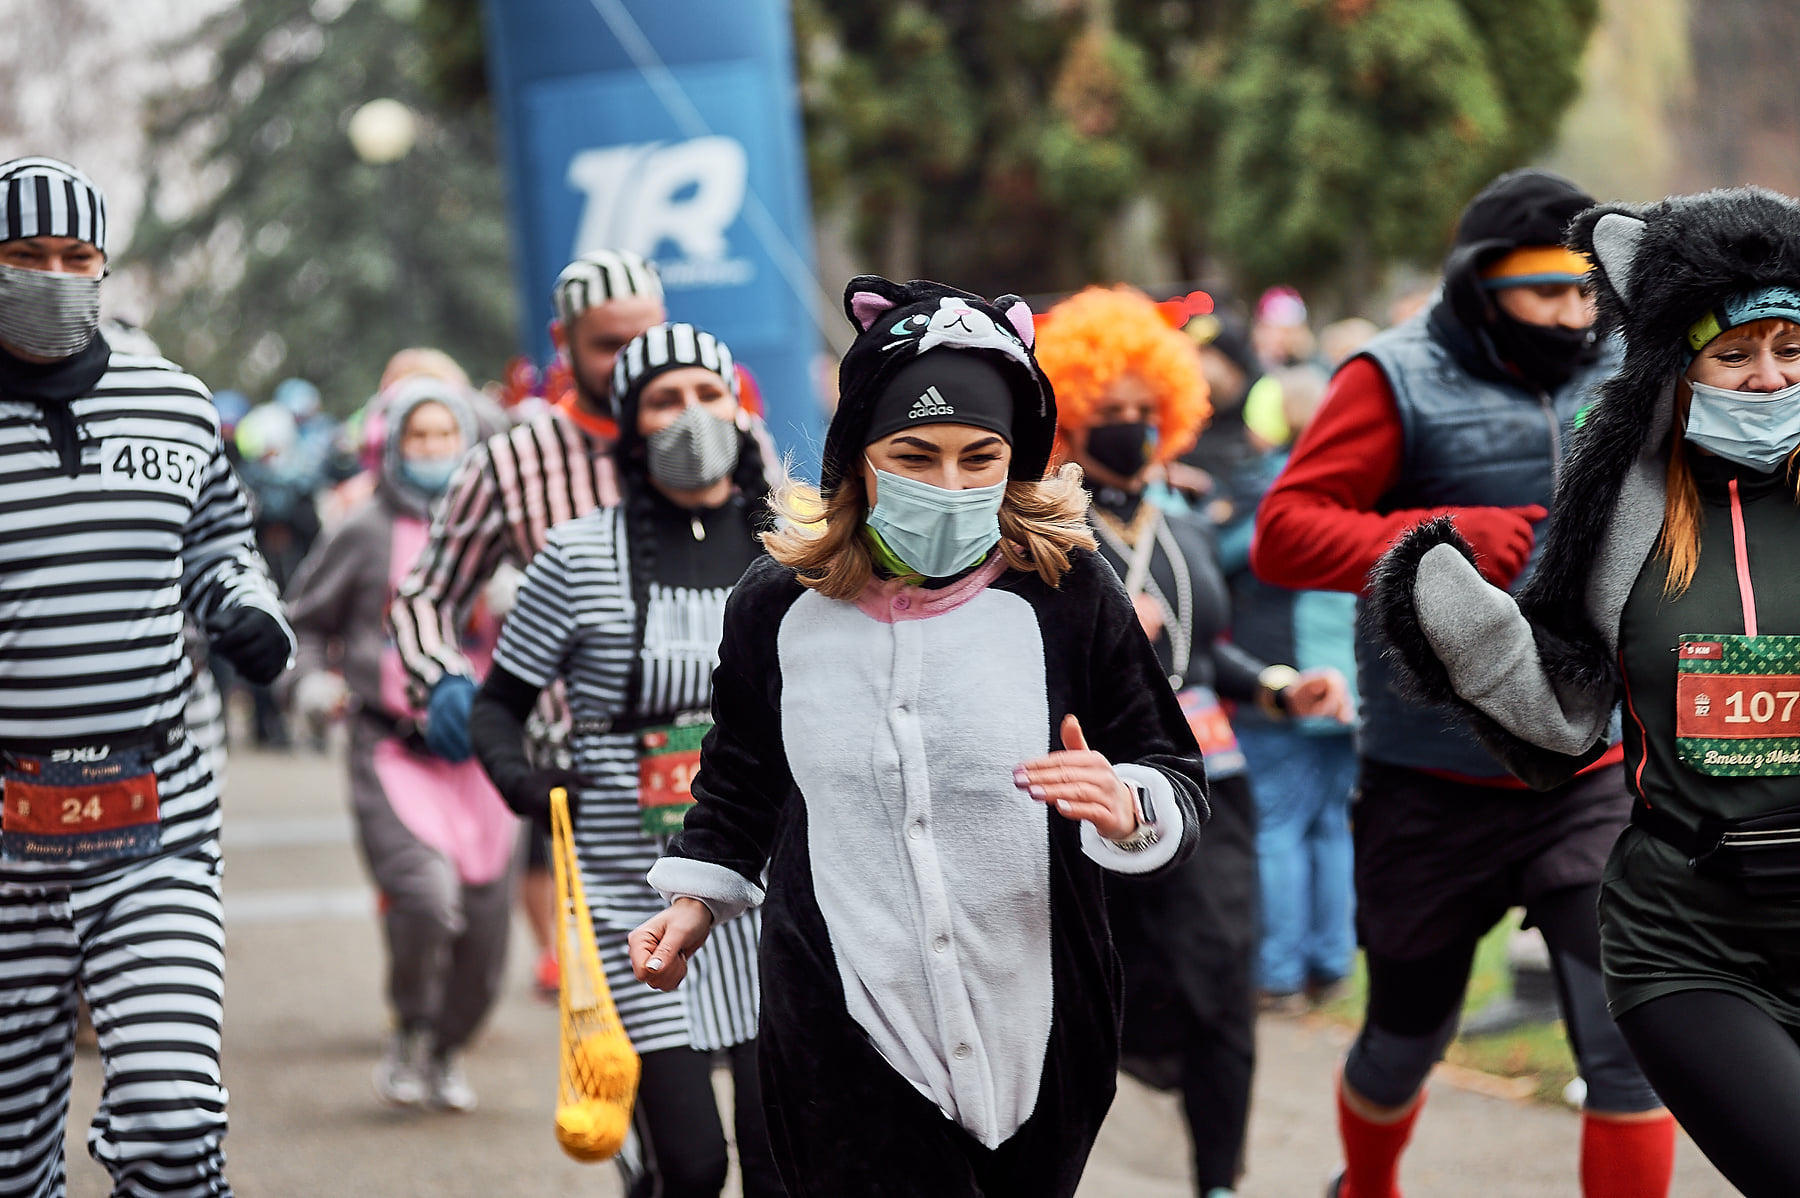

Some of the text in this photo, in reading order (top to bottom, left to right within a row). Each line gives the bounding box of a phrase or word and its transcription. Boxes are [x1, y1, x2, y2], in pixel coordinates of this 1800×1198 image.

[908, 403, 954, 419] adidas
[112, 444, 196, 489] 4852
[1724, 690, 1800, 723] 107
[61, 794, 103, 824] 24
